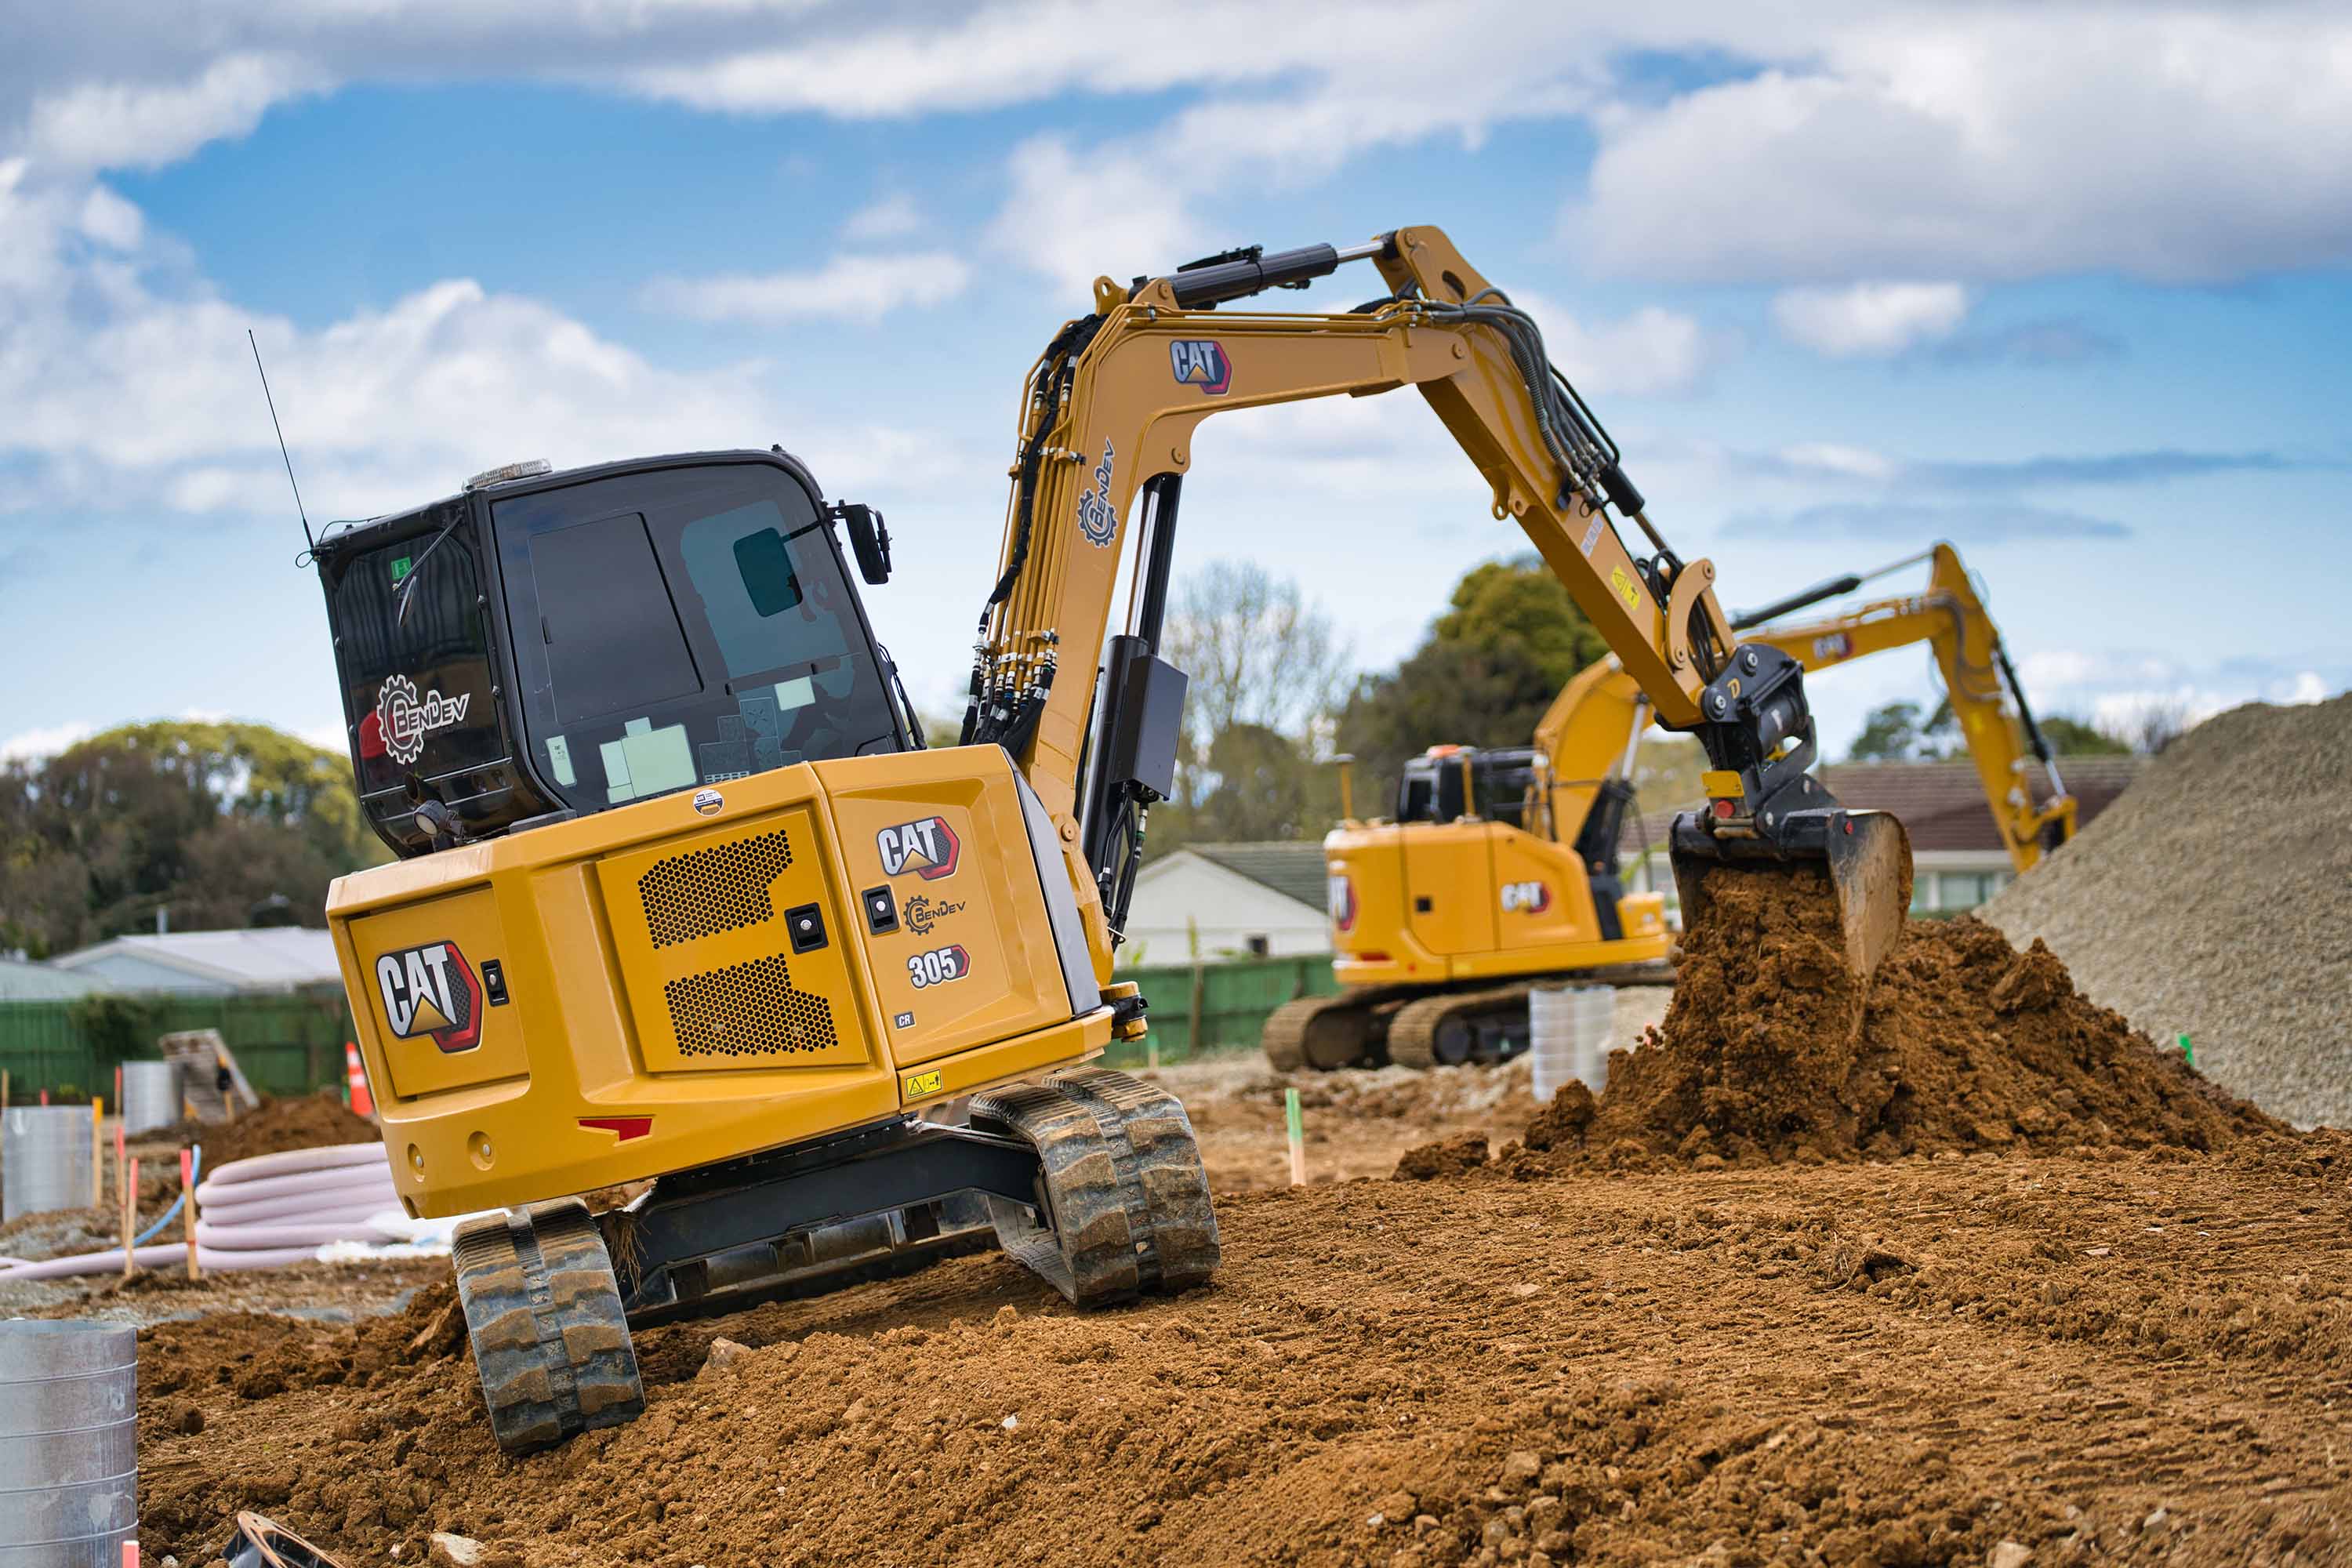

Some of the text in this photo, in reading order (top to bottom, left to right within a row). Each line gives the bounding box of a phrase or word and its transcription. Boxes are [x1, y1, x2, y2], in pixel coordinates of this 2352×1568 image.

[1171, 342, 1217, 383] CAT
[878, 818, 939, 874] CAT
[908, 947, 956, 988] 305
[377, 945, 457, 1036] CAT
[898, 1014, 911, 1026] CR
